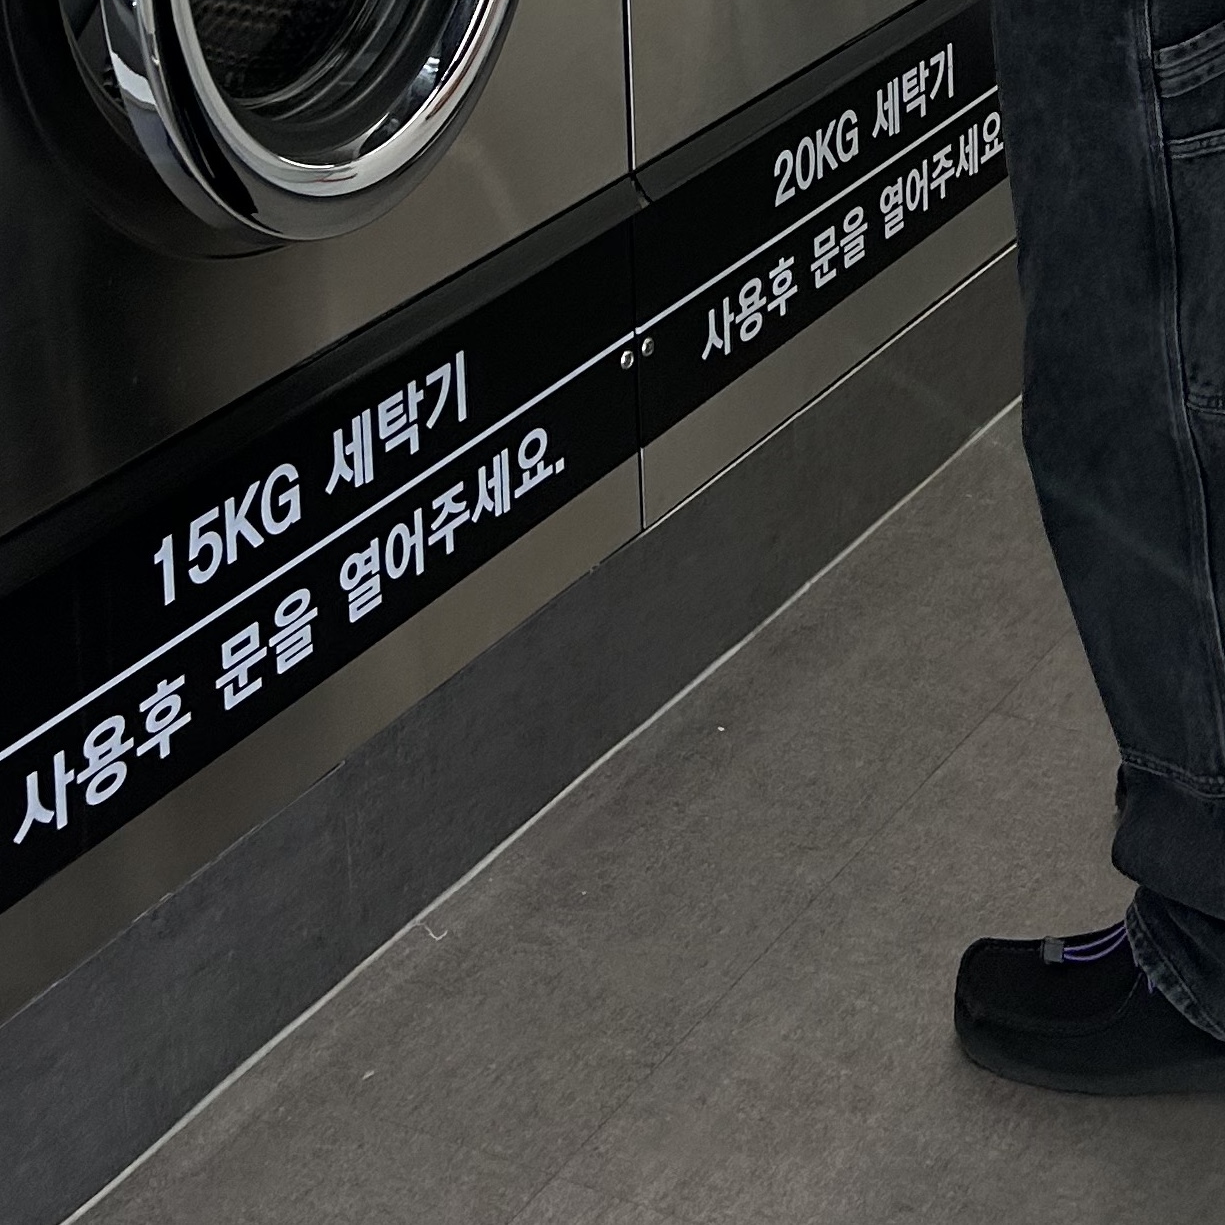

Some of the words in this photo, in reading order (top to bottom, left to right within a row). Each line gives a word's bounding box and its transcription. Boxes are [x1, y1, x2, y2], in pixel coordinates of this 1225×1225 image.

[701, 255, 798, 361] 사용후
[810, 205, 869, 289] 문을
[879, 111, 1004, 240] 열어주세요
[773, 109, 859, 208] 20KG
[872, 42, 954, 138] 세탁기
[153, 462, 301, 606] 15KG
[325, 350, 468, 496] 세탁기
[13, 675, 192, 845] 사용후
[215, 588, 320, 712] 문을
[339, 427, 566, 624] 열어주세요.
